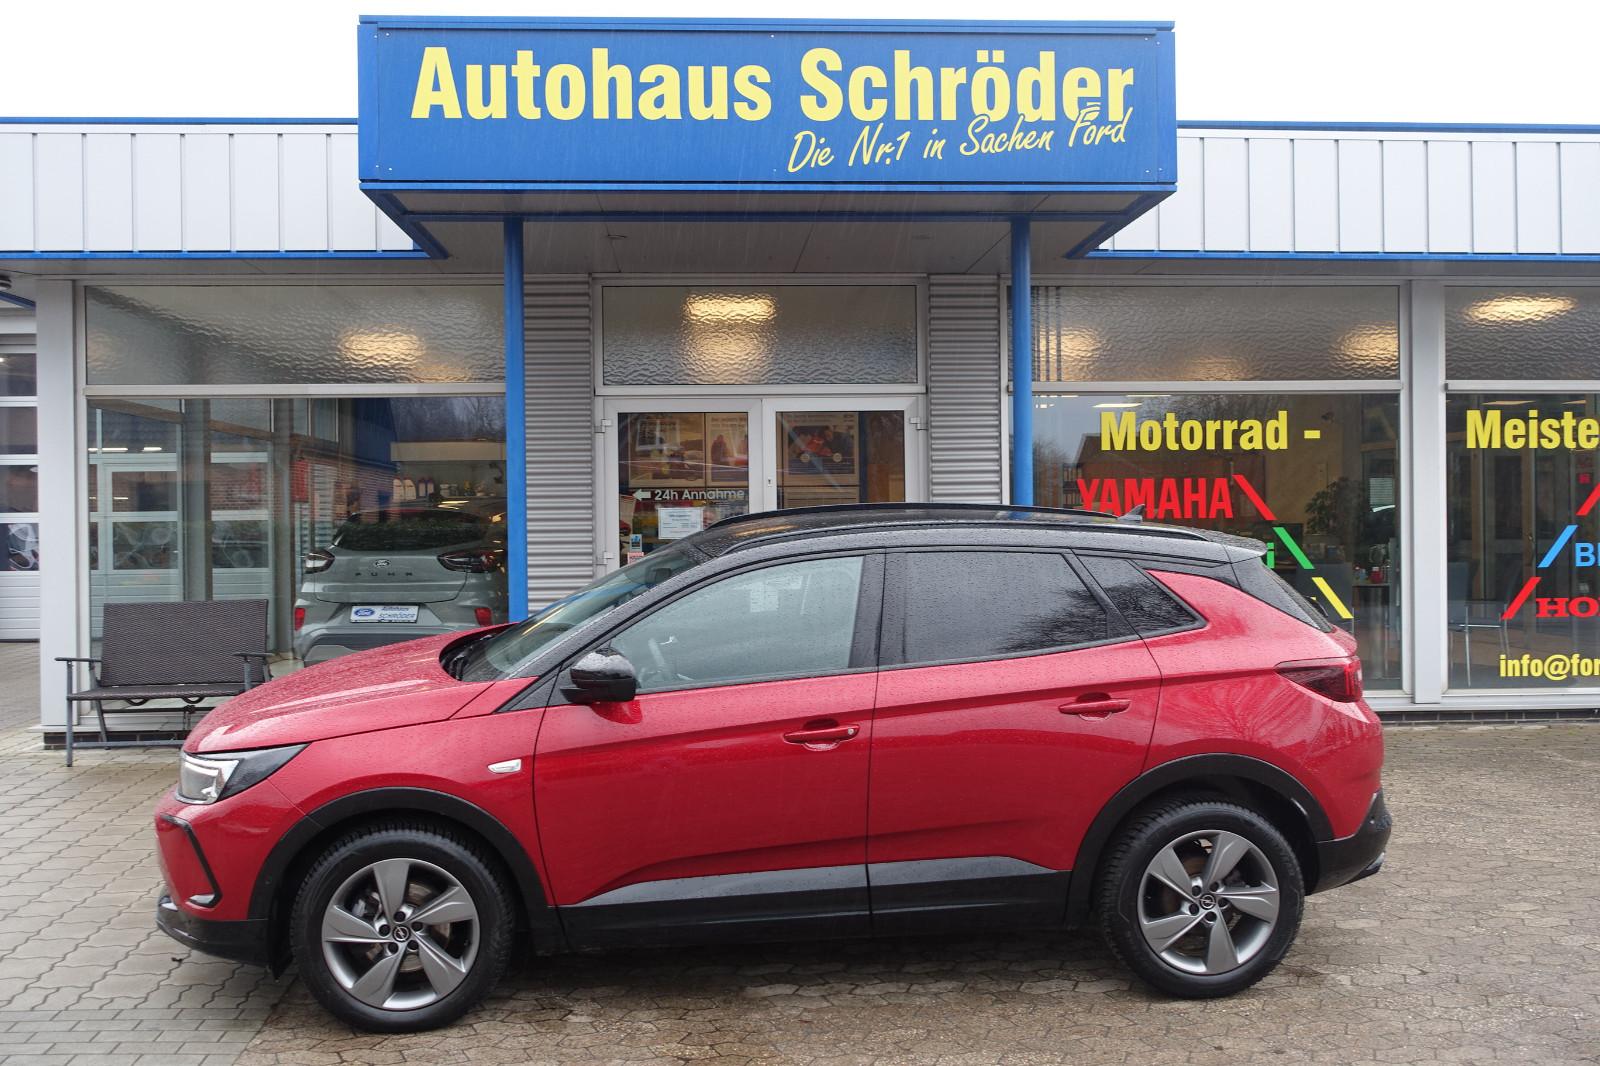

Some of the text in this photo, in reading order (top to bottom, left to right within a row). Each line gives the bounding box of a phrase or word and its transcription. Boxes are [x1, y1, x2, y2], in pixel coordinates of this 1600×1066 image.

[412, 47, 1133, 122] Autohaus Schröder
[787, 105, 1134, 173] Die Nr.1 in Sachen Ford
[1100, 410, 1288, 451] Motorrad
[654, 489, 745, 501] 24h Annahme
[1076, 477, 1235, 520] YAMAHA
